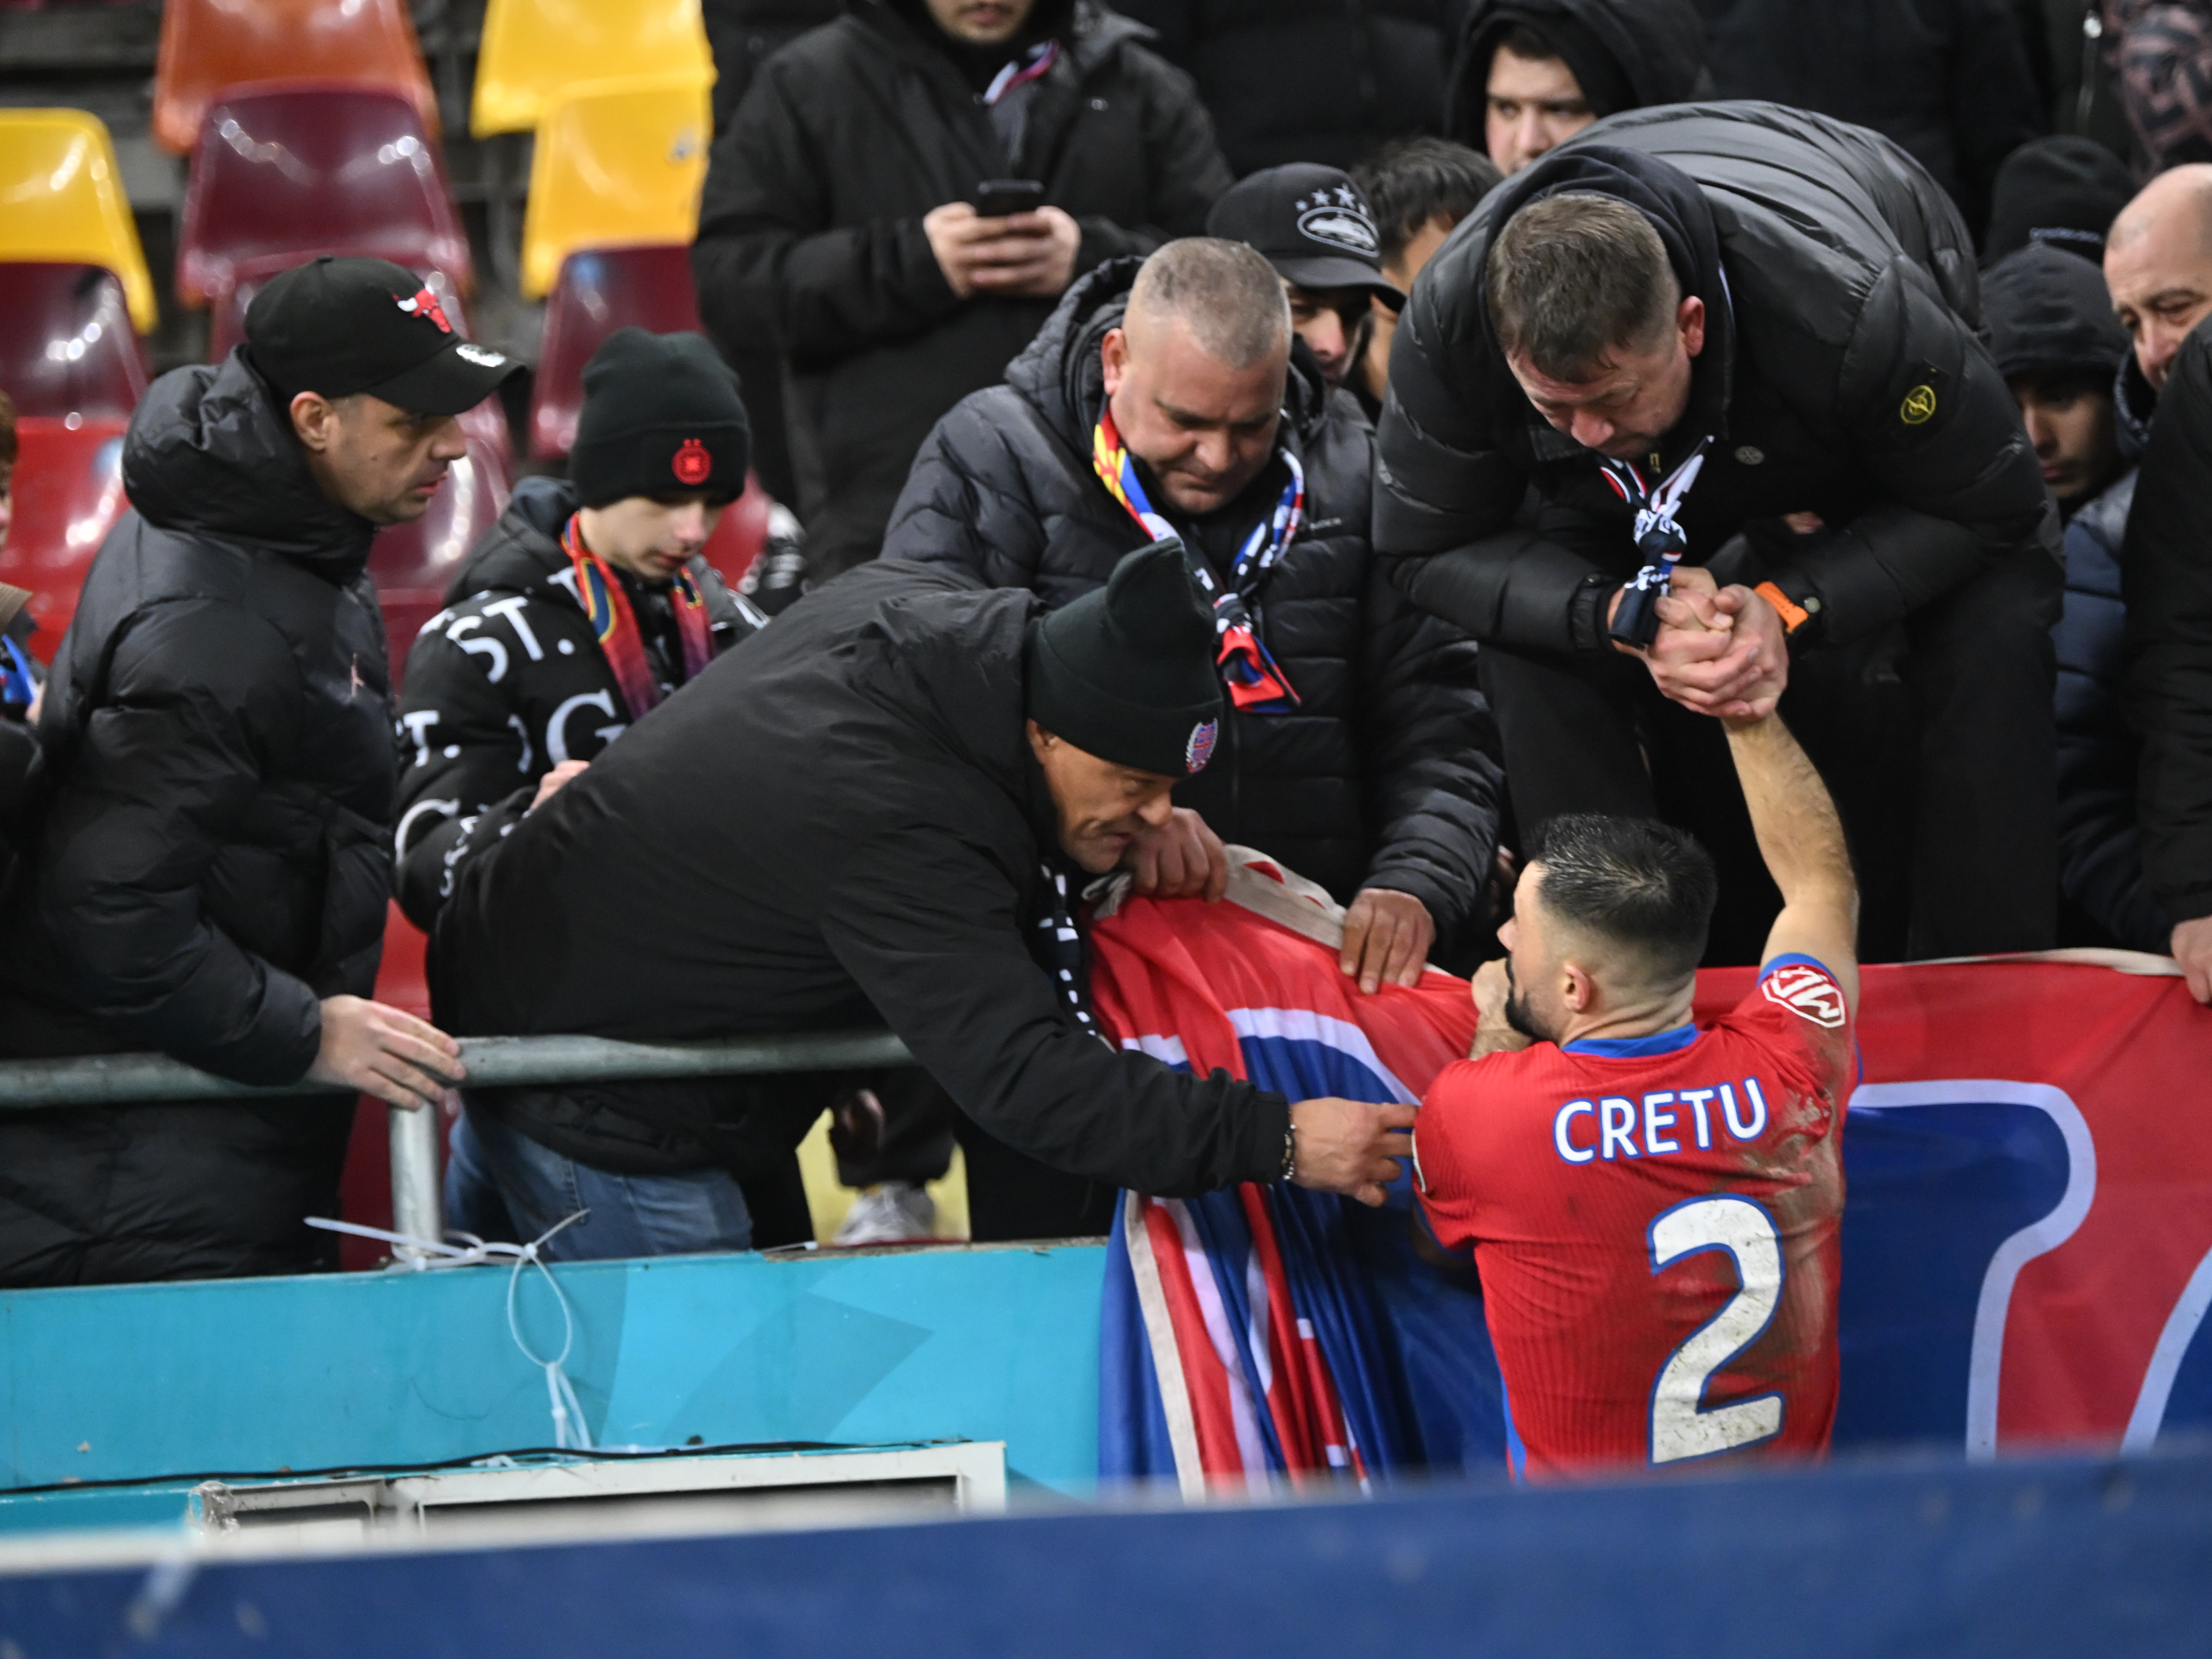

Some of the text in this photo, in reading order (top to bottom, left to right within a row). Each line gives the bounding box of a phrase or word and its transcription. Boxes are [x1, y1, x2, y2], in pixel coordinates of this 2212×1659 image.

[446, 596, 575, 684] ST.
[1552, 1076, 1768, 1165] CRETU
[1648, 1192, 1786, 1469] 2
